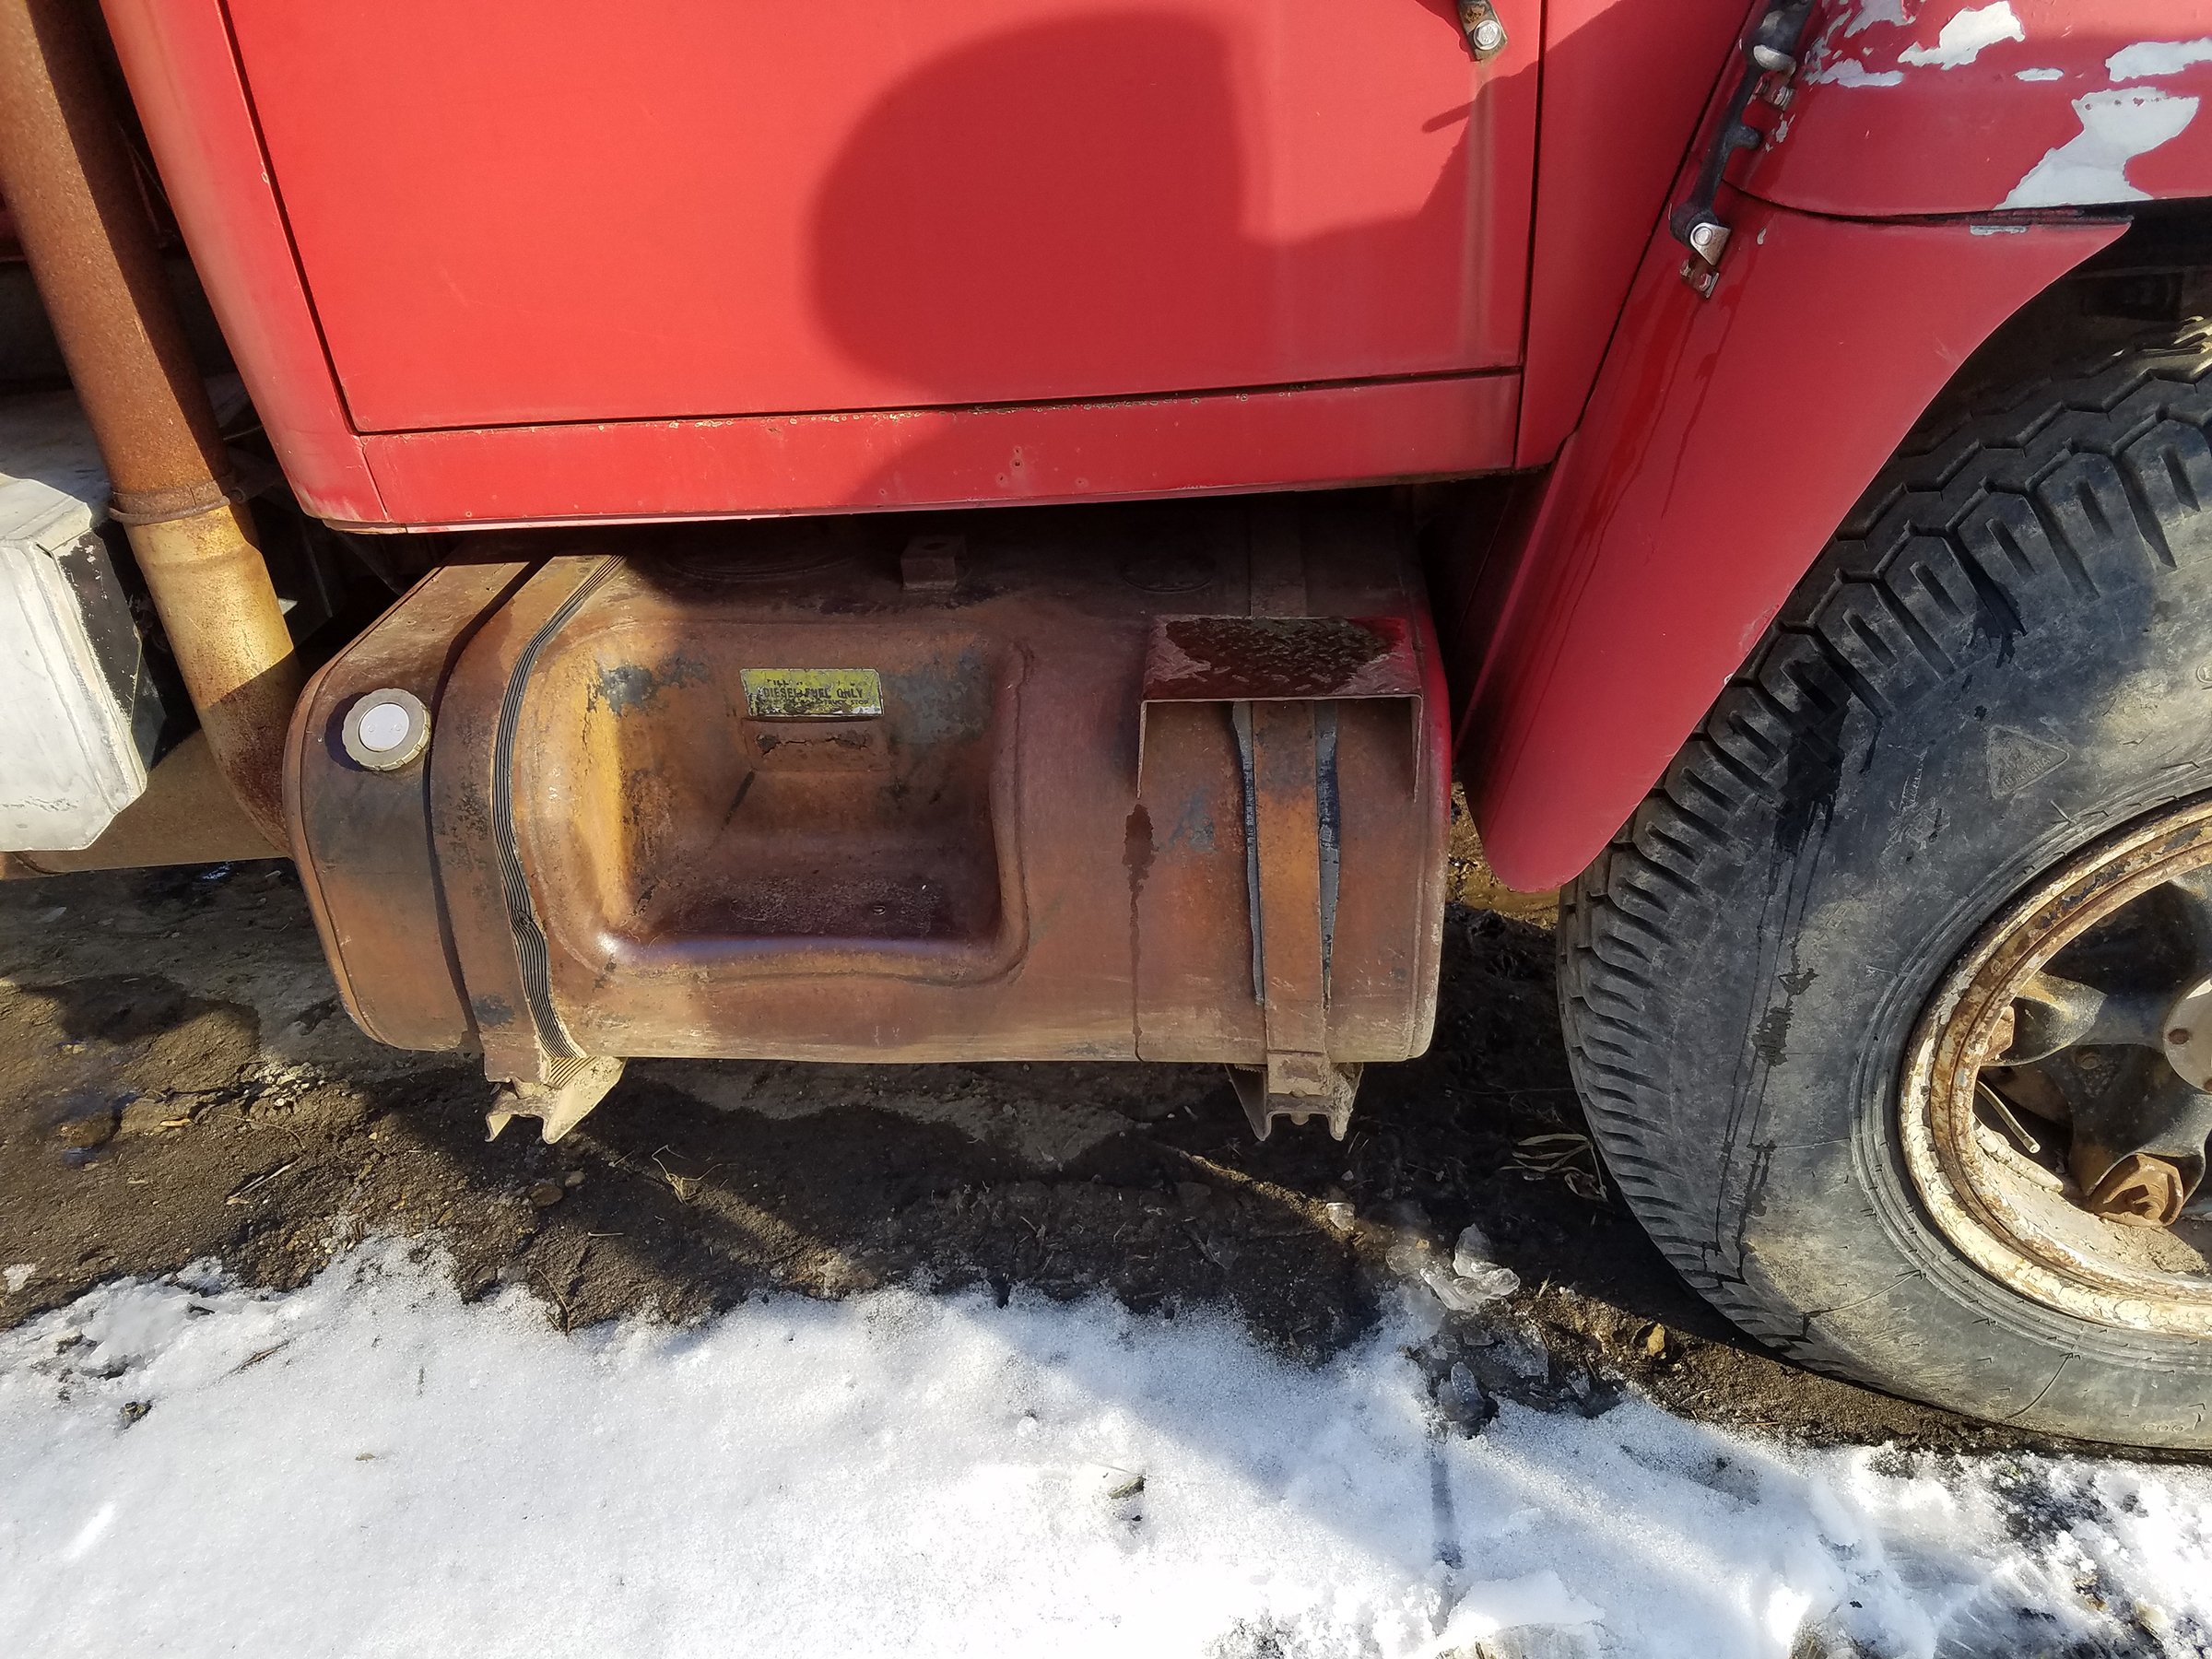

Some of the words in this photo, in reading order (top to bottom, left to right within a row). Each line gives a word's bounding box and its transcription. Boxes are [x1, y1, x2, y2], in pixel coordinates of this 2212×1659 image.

[764, 688, 801, 700] DIESEL
[805, 688, 831, 699] FUEL
[837, 688, 864, 699] ONLY
